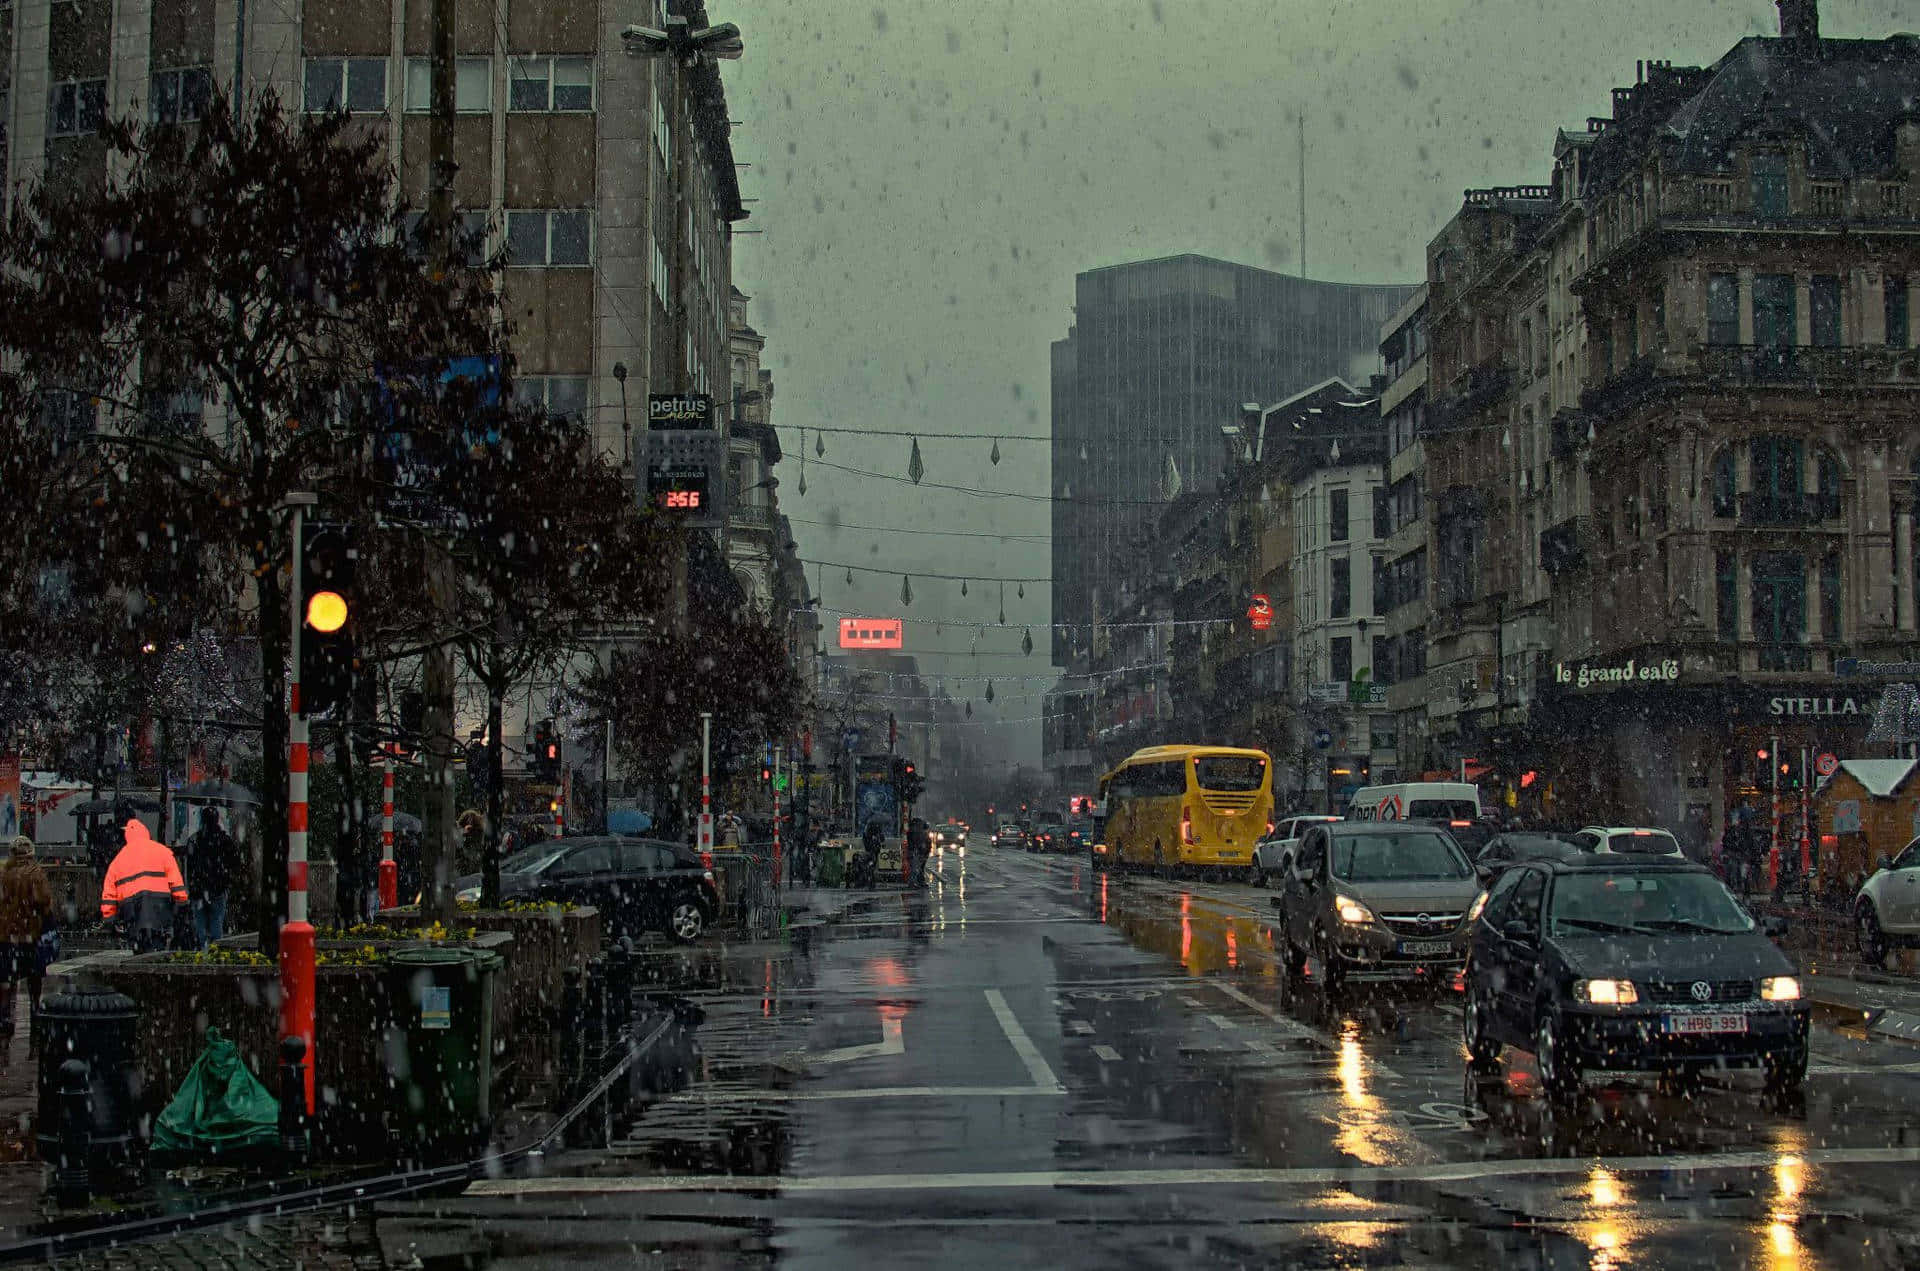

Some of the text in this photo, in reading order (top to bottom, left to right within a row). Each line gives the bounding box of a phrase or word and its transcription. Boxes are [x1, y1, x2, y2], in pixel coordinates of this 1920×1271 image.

[650, 397, 706, 417] petrus
[654, 410, 704, 421] neon
[1555, 659, 1679, 688] le grand café
[1770, 697, 1859, 715] STELLA
